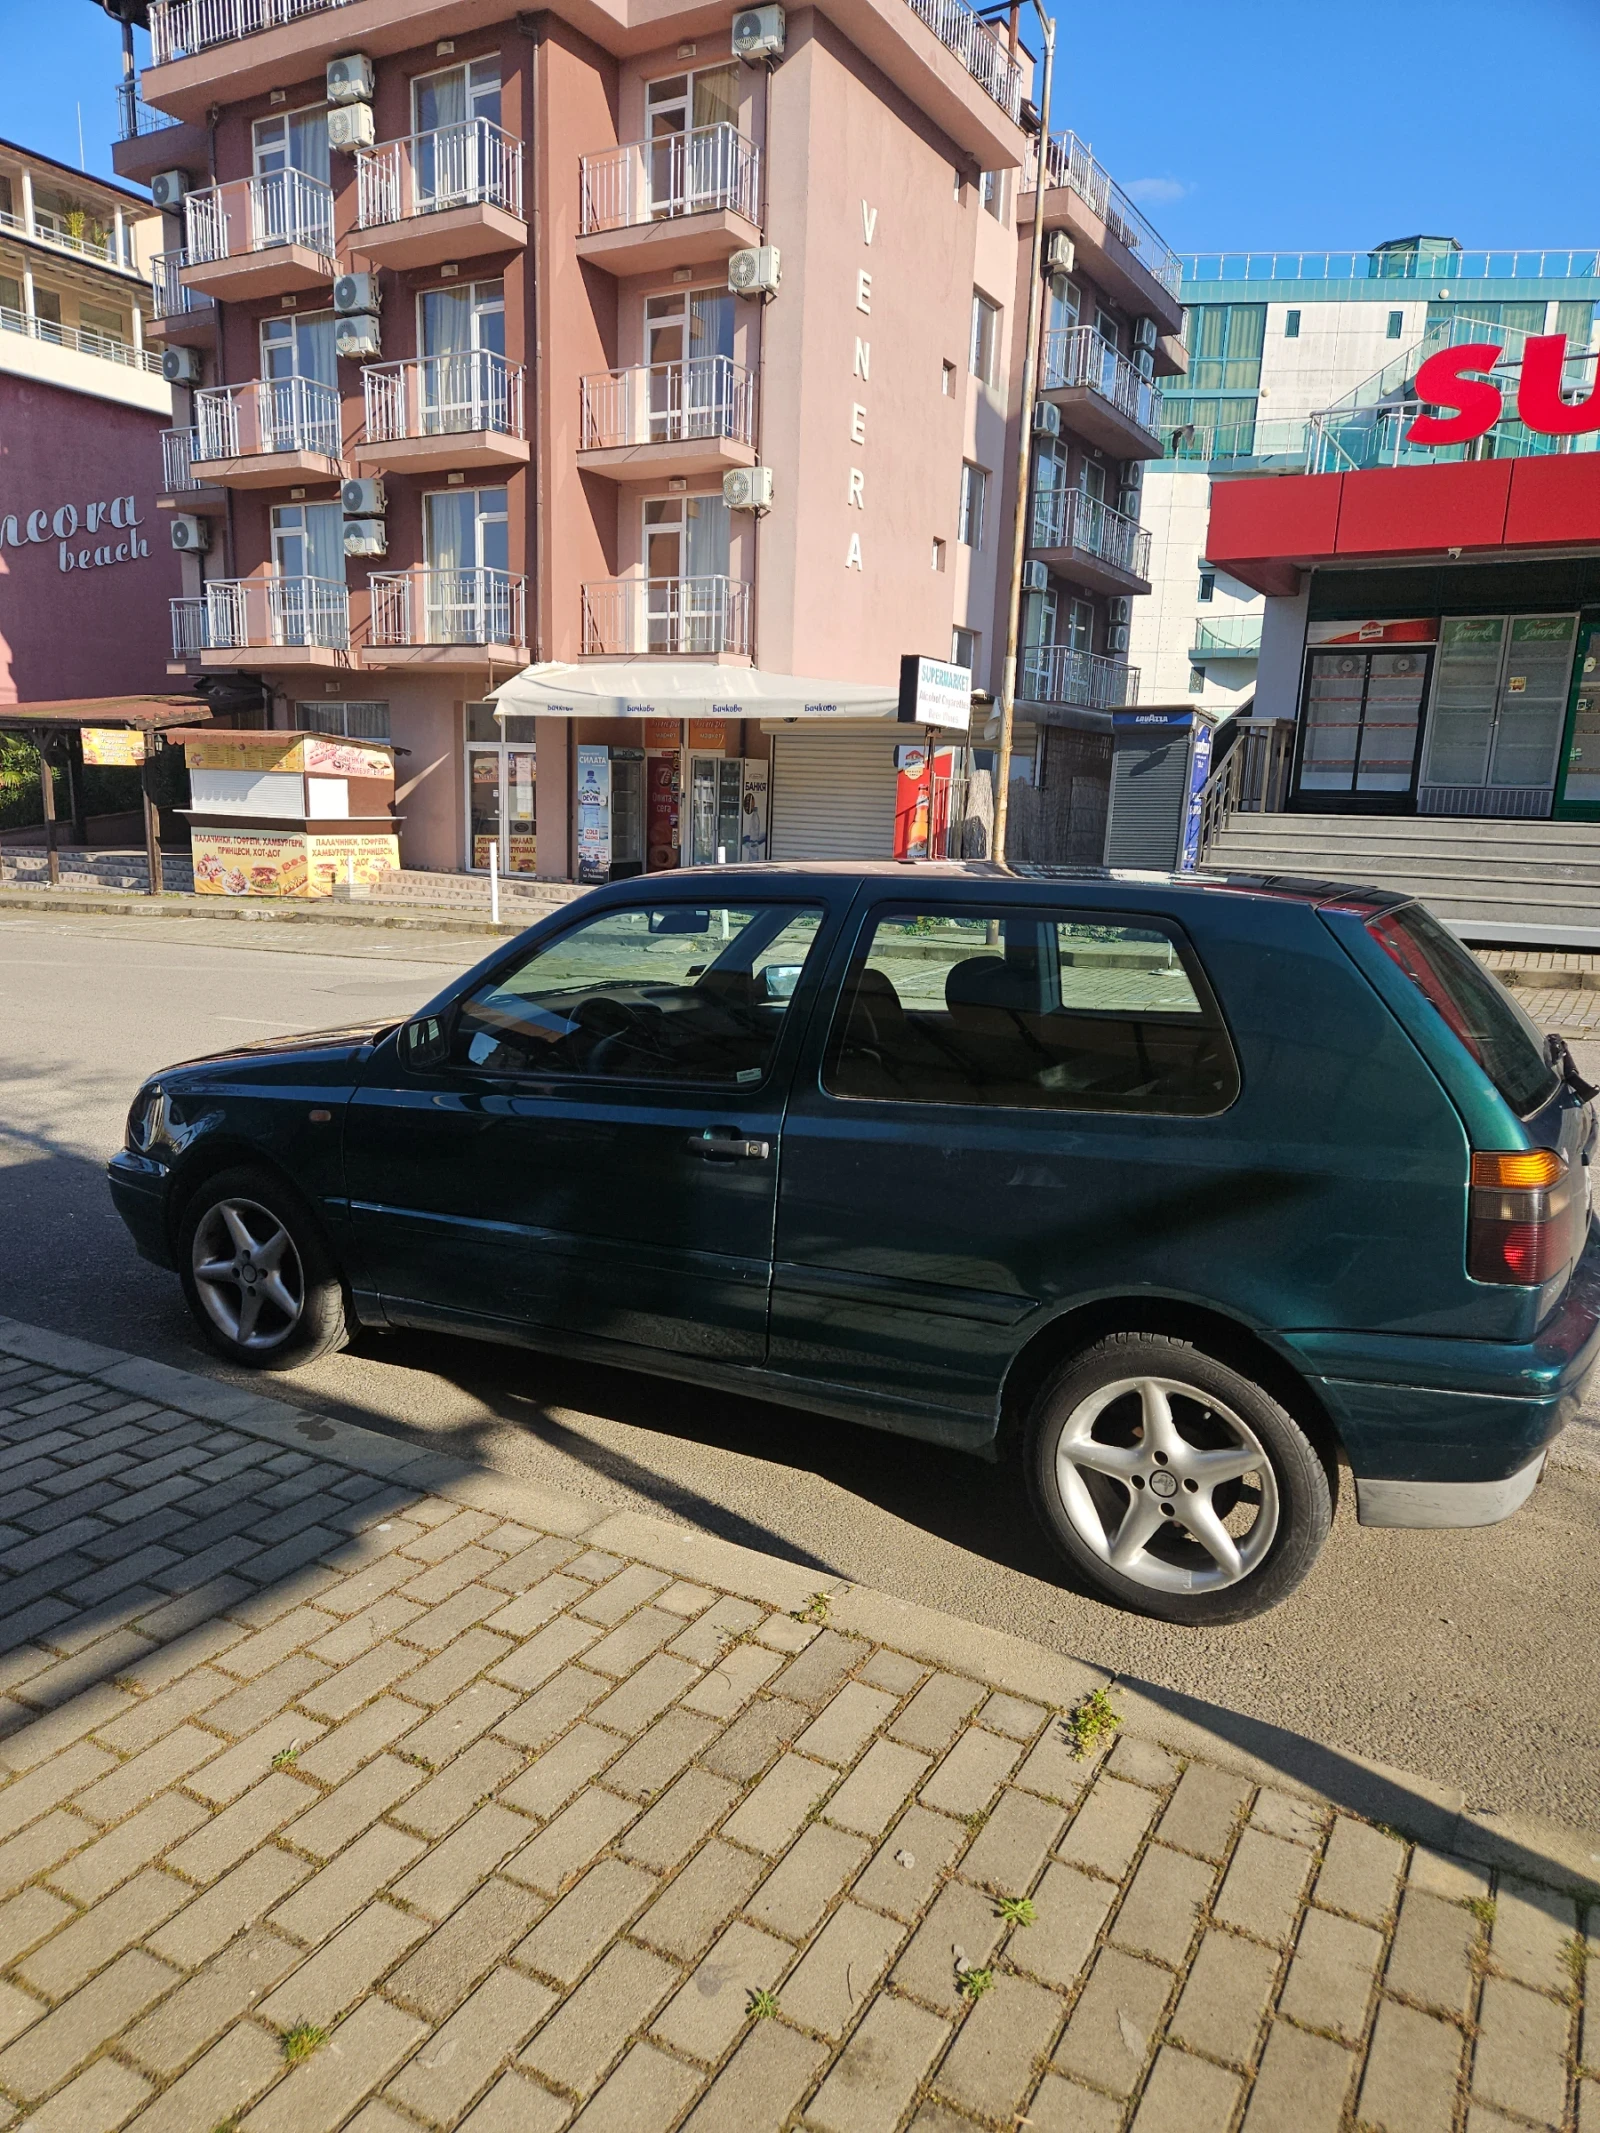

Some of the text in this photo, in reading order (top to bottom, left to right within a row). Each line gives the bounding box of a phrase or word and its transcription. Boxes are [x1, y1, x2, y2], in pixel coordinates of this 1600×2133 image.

[845, 199, 878, 572] VENERA
[1405, 333, 1600, 446] SU
[59, 528, 153, 573] beach
[921, 665, 969, 692] SUPERMARKET
[919, 690, 940, 704] Alcohol
[712, 704, 743, 713] Бачково
[804, 703, 837, 712] Бачково
[1135, 713, 1168, 723] LAVAZZA
[579, 756, 607, 764] СИЛАТА
[745, 782, 766, 791] БАНКЯ
[195, 834, 305, 848] ПАЛАЧИНКИ, ГОФРЕТИ, ХАМБУРГЕРИ,
[316, 838, 359, 846] ПАЛАЧИНКИ,
[218, 846, 280, 857] ПРИНЦЕСИ, ХОТ-ДОГ
[312, 848, 357, 857] ХАМБУРГЕРИ,
[340, 858, 369, 866] ХО-ДОГ
